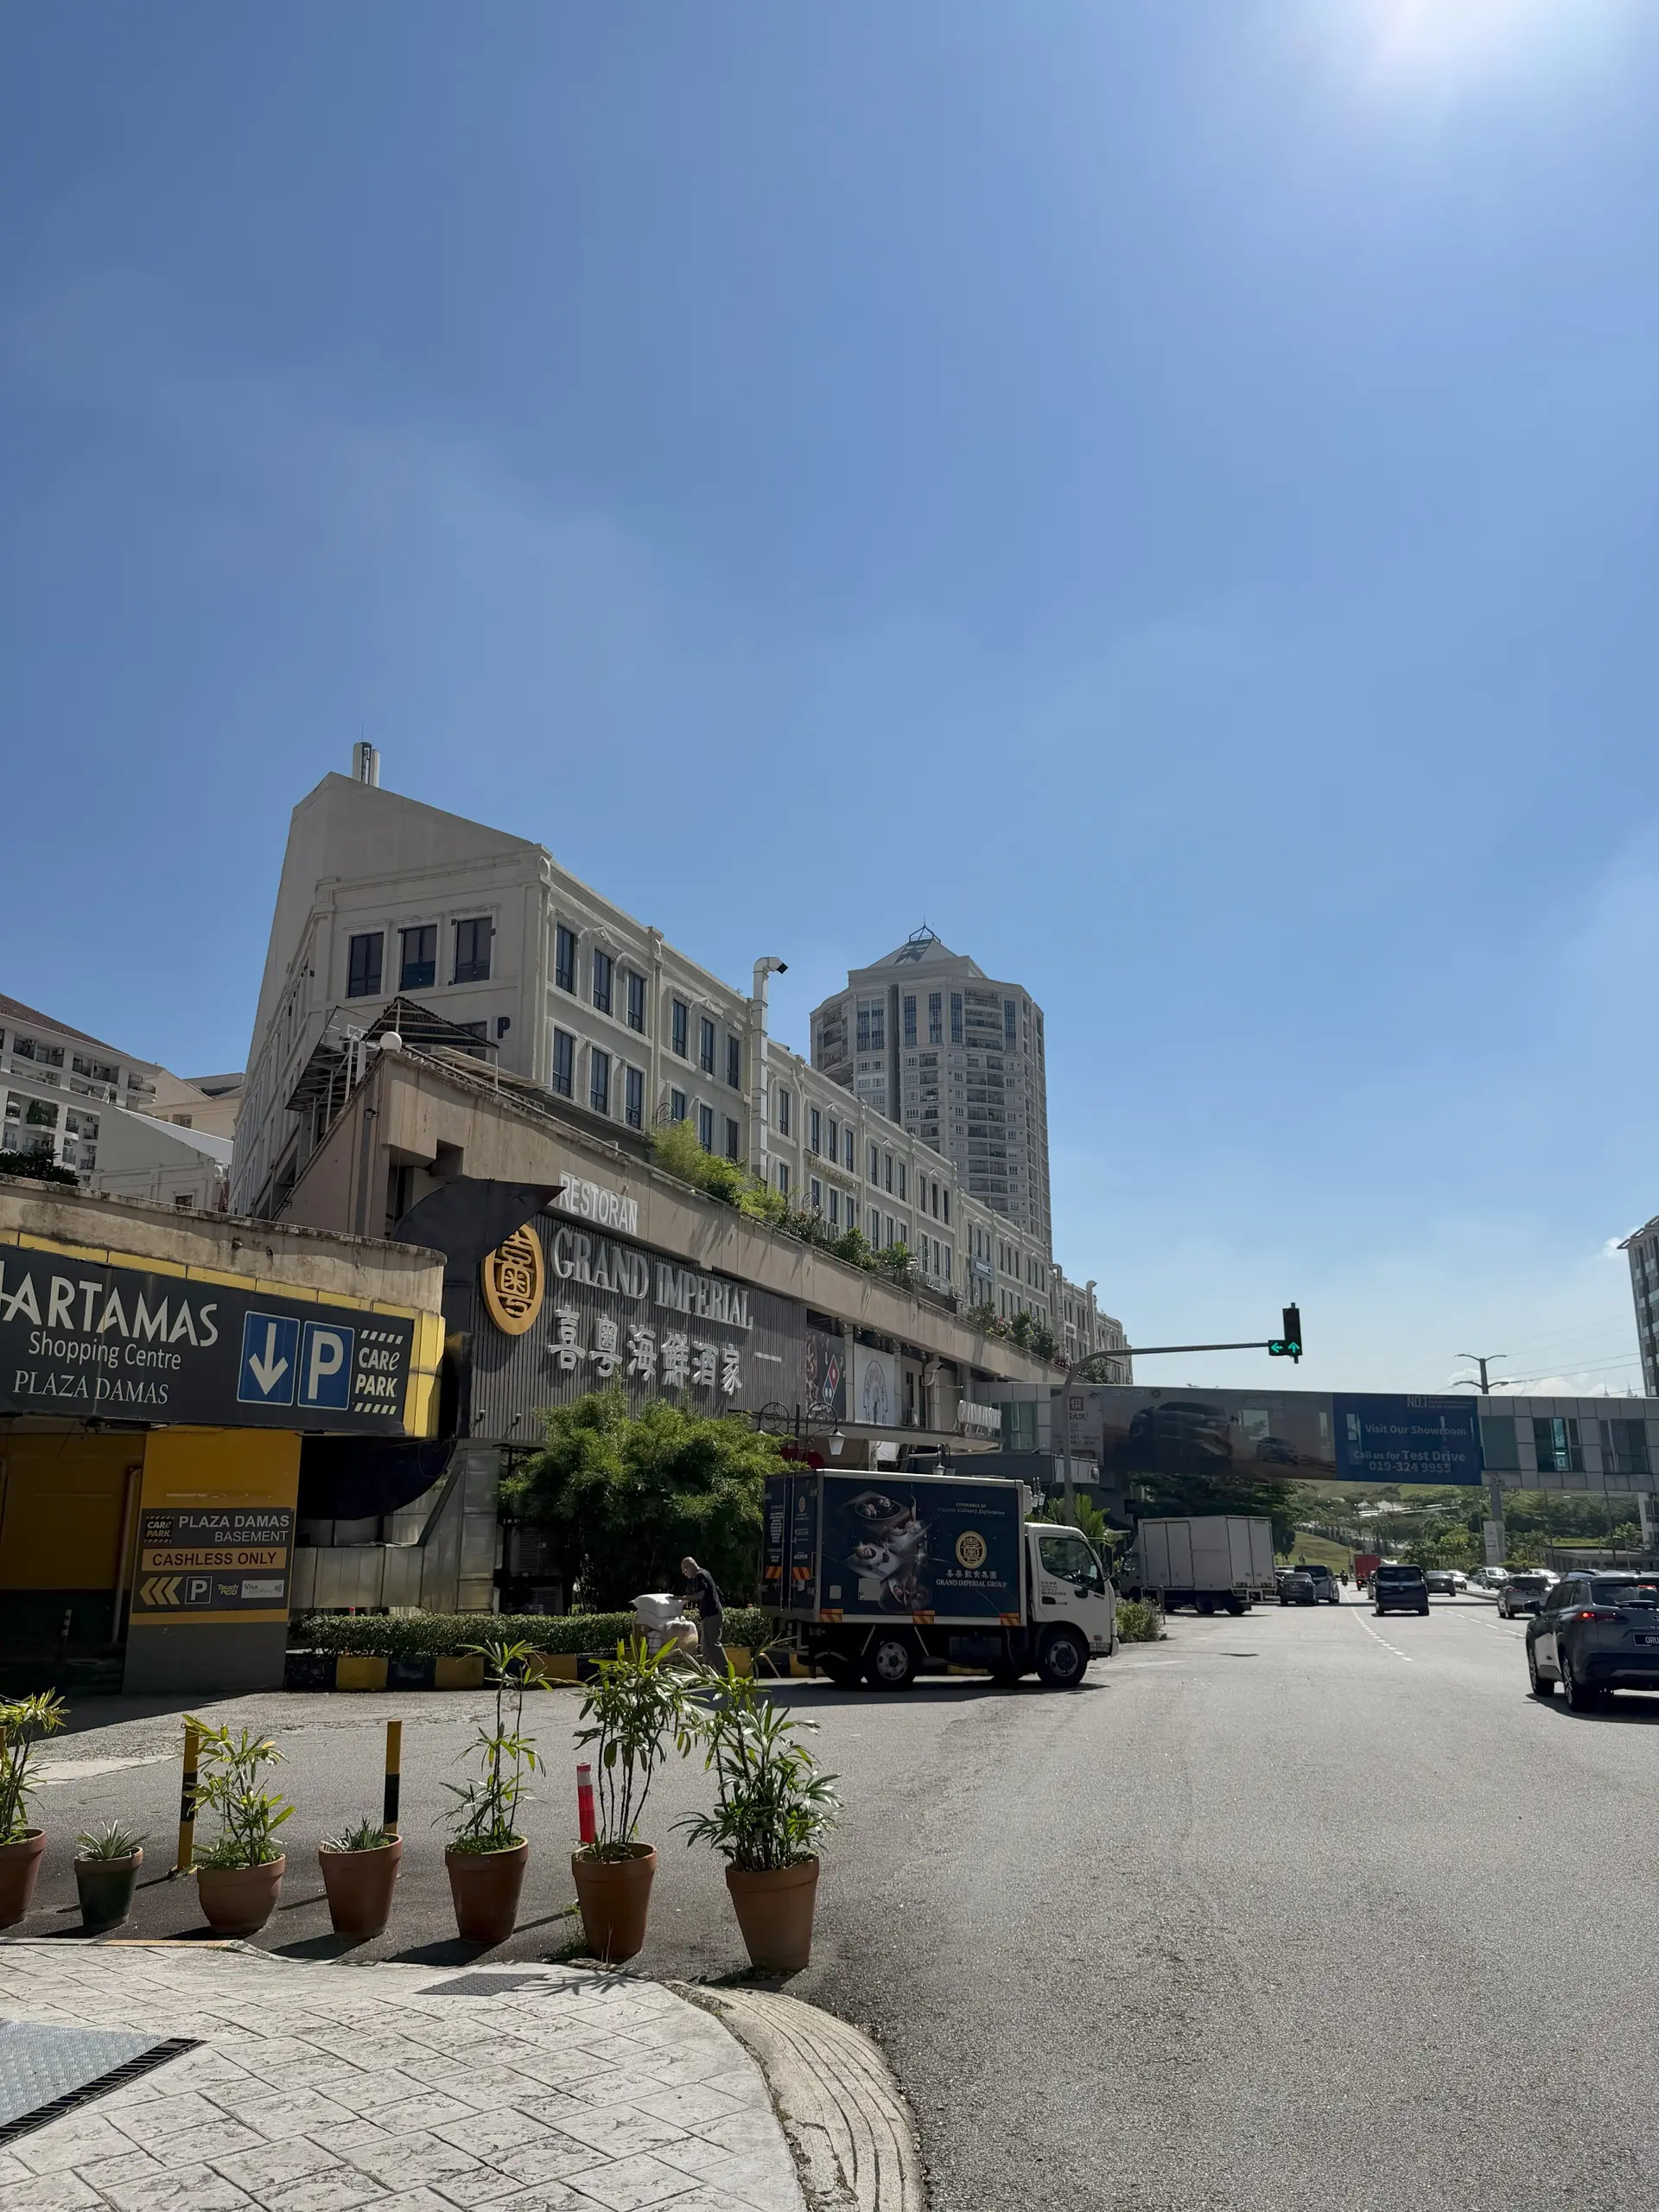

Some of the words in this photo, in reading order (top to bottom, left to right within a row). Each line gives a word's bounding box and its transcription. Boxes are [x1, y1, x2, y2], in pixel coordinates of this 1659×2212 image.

[558, 1173, 639, 1236] RESTORAN
[550, 1227, 649, 1300] GRAND
[653, 1262, 753, 1331] IMPERIAL
[29, 1330, 120, 1369] Shopping
[125, 1344, 182, 1370] Centre
[308, 1330, 344, 1400] P
[12, 1370, 90, 1398] PLAZA
[93, 1377, 169, 1405] DAMAS
[354, 1373, 398, 1398] PARK
[1407, 1395, 1427, 1408] NO.1
[1365, 1424, 1388, 1434] Visit
[1389, 1425, 1408, 1434] Our
[1411, 1425, 1467, 1436] Showroom
[1353, 1450, 1372, 1459] Call
[1373, 1452, 1384, 1460] us
[1386, 1451, 1401, 1461] for
[1402, 1449, 1430, 1460] Test
[1432, 1450, 1466, 1462] Drive
[1369, 1459, 1419, 1472] 019-324
[1421, 1461, 1452, 1474] 9955
[178, 1515, 231, 1529] PLAZA
[234, 1515, 290, 1528] DAMAS
[214, 1530, 289, 1542] BASEMENT
[152, 1553, 233, 1567] CASHLESS
[238, 1552, 277, 1565] ONLY
[190, 1580, 208, 1601] P
[987, 1580, 1007, 1589] GROUP
